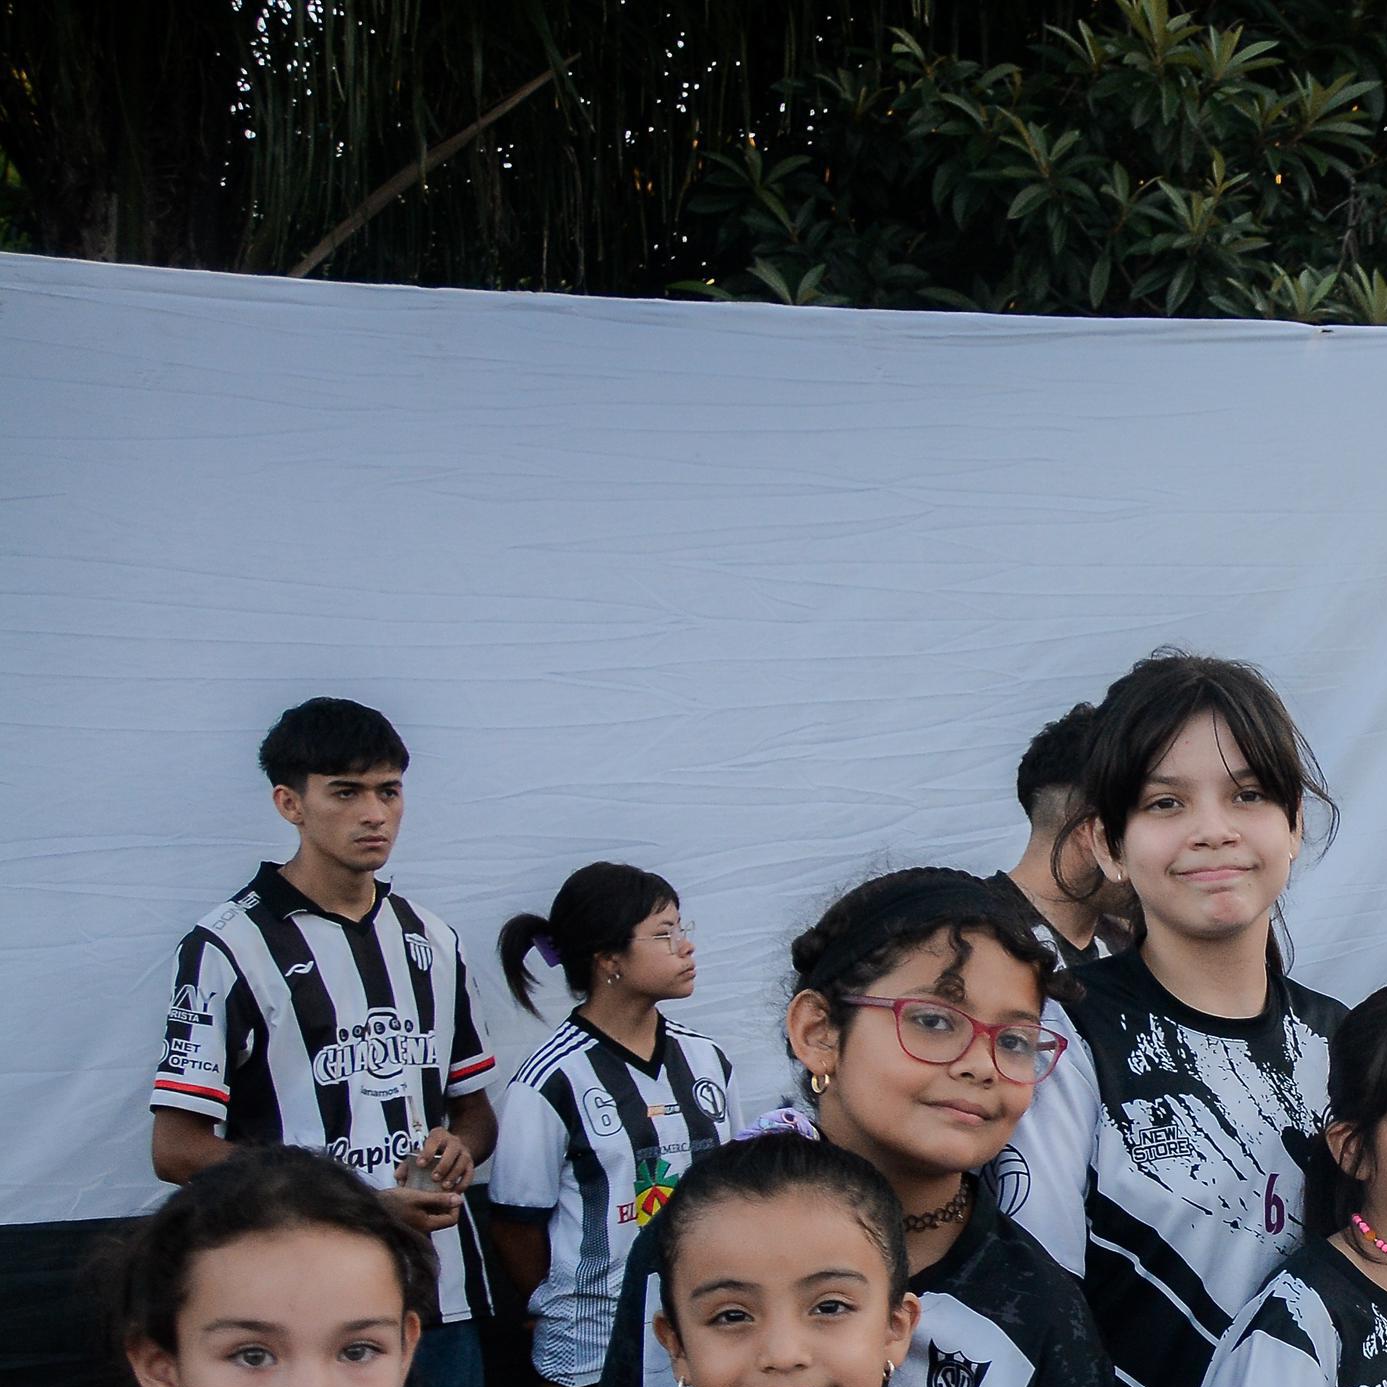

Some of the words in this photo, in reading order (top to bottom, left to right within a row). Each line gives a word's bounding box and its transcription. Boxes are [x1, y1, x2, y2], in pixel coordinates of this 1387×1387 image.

[173, 1039, 201, 1053] NET
[169, 1056, 220, 1073] OPTICA
[583, 1088, 623, 1136] 6
[1142, 1127, 1177, 1146] NEW
[1134, 1140, 1191, 1162] STORE
[617, 1202, 638, 1224] EL
[1264, 1173, 1285, 1235] 6
